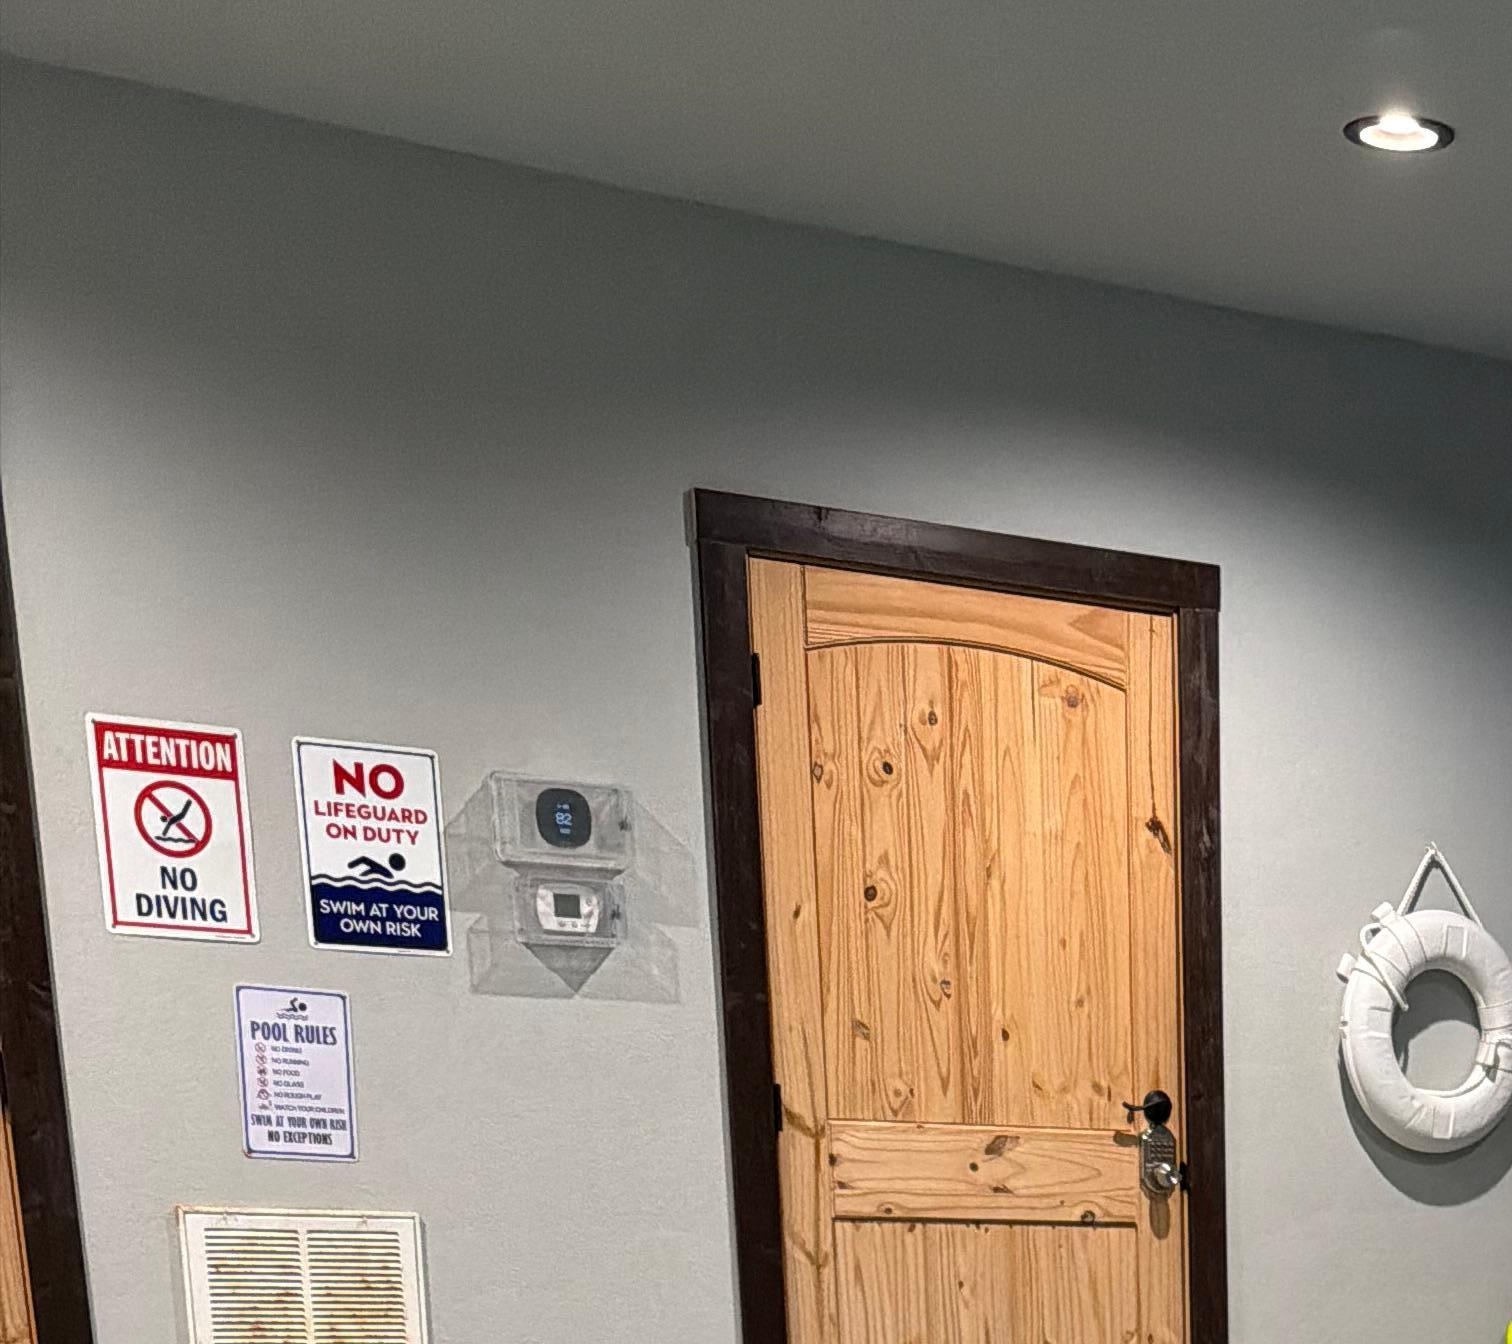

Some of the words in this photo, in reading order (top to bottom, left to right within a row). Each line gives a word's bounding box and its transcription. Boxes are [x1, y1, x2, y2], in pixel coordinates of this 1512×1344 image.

[103, 730, 233, 773] ATTENTION
[332, 758, 405, 801] NO
[313, 799, 428, 825] LIFEGUARD
[325, 823, 357, 841] ON
[363, 825, 420, 846] DUTY
[159, 865, 198, 892] NO
[135, 892, 228, 923] DIVING
[319, 898, 366, 917] SWIM
[369, 902, 389, 918] AT
[392, 904, 439, 922] YOUR
[340, 917, 382, 935] OWN
[386, 921, 422, 938] RISK
[250, 1020, 290, 1043] POOL
[294, 1023, 338, 1046] RULES
[271, 1057, 282, 1065] NO
[272, 1068, 282, 1076] NO
[282, 1069, 301, 1077] FOOD
[283, 1080, 305, 1088] GLASS
[274, 1104, 297, 1112] WATCH
[251, 1113, 273, 1127] SWIM
[275, 1114, 285, 1128] AT
[287, 1115, 308, 1129] YOUR
[309, 1117, 328, 1130] OWN
[329, 1118, 348, 1132] RISK
[267, 1129, 281, 1143] NO
[283, 1130, 334, 1146] EXCEPTIONS
